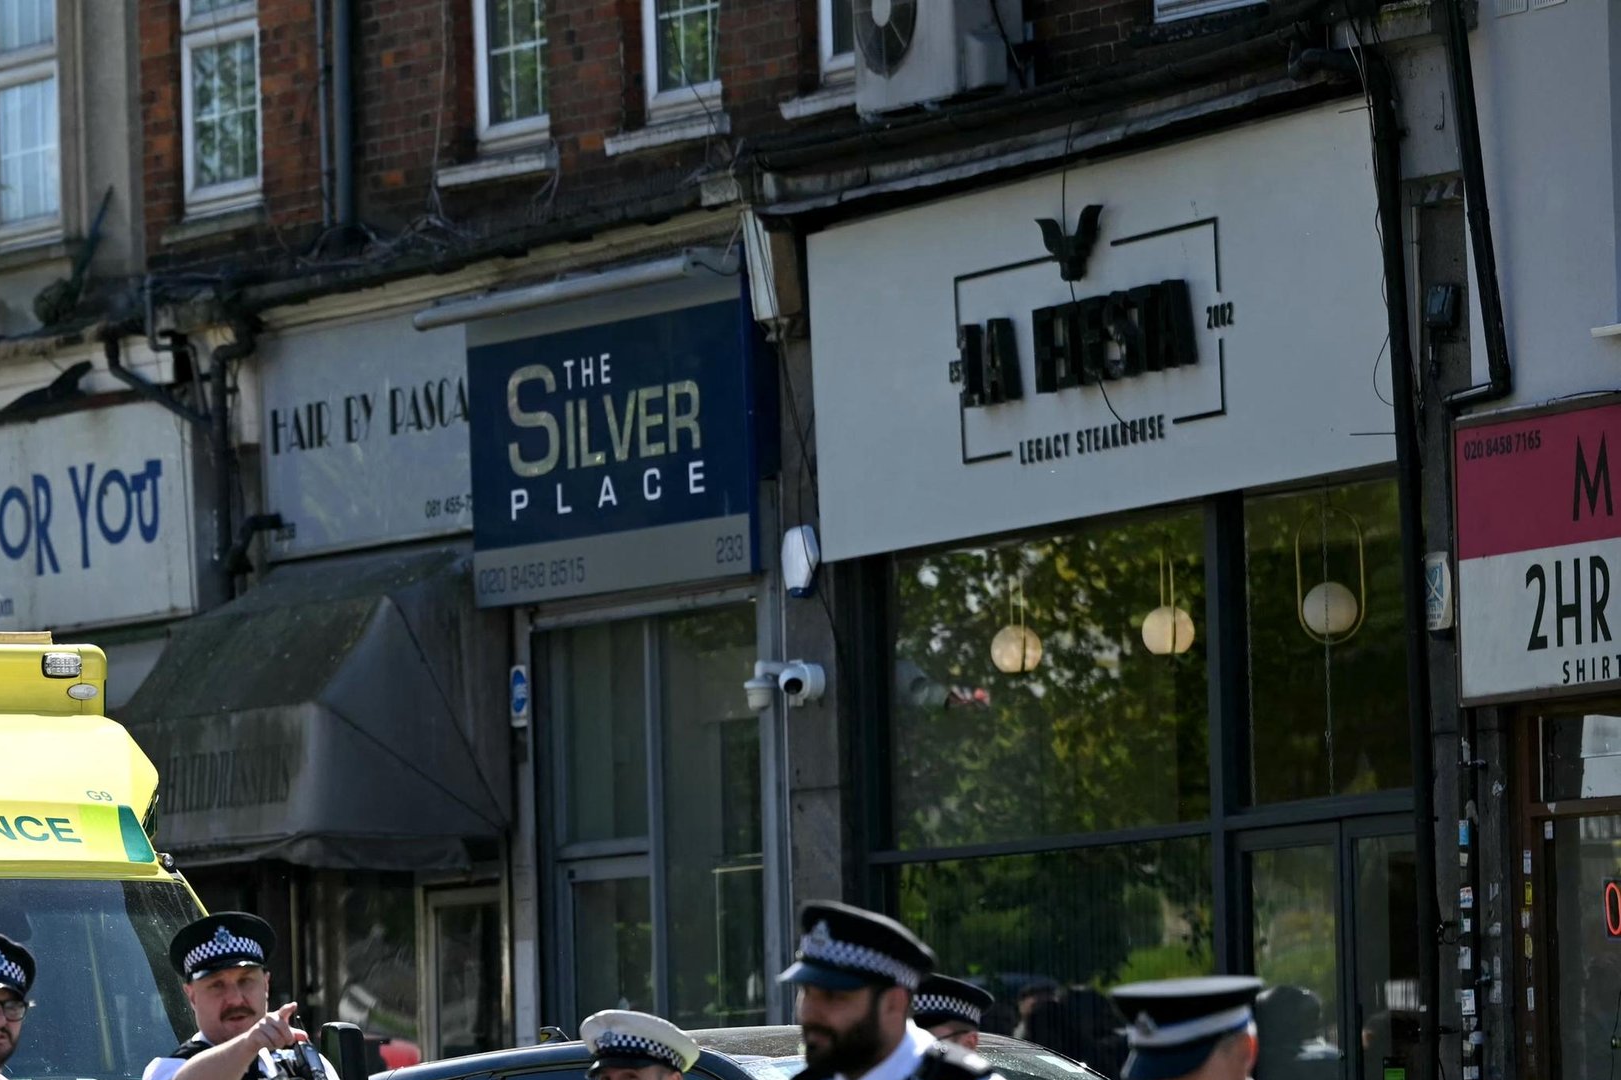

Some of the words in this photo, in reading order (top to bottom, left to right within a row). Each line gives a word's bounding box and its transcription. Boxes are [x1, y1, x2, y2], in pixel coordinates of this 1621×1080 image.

[1206, 302, 1234, 329] 2002
[563, 353, 611, 390] THE
[271, 402, 332, 455] HAIR
[345, 392, 377, 443] BY
[507, 364, 701, 477] SILVER
[1019, 432, 1071, 465] LEGACY
[1076, 414, 1166, 455] STEAKHOUSE
[1464, 440, 1483, 461] 020
[1486, 434, 1512, 457] 8458
[1515, 430, 1541, 452] 7165
[511, 460, 705, 521] PLACE
[1573, 430, 1614, 521] M
[68, 459, 162, 570] YOU
[715, 536, 744, 564] 233
[479, 567, 505, 595] 020
[511, 562, 545, 591] 8458
[550, 557, 586, 587] 8515
[1525, 554, 1613, 651] 2HR
[86, 790, 113, 801] G9
